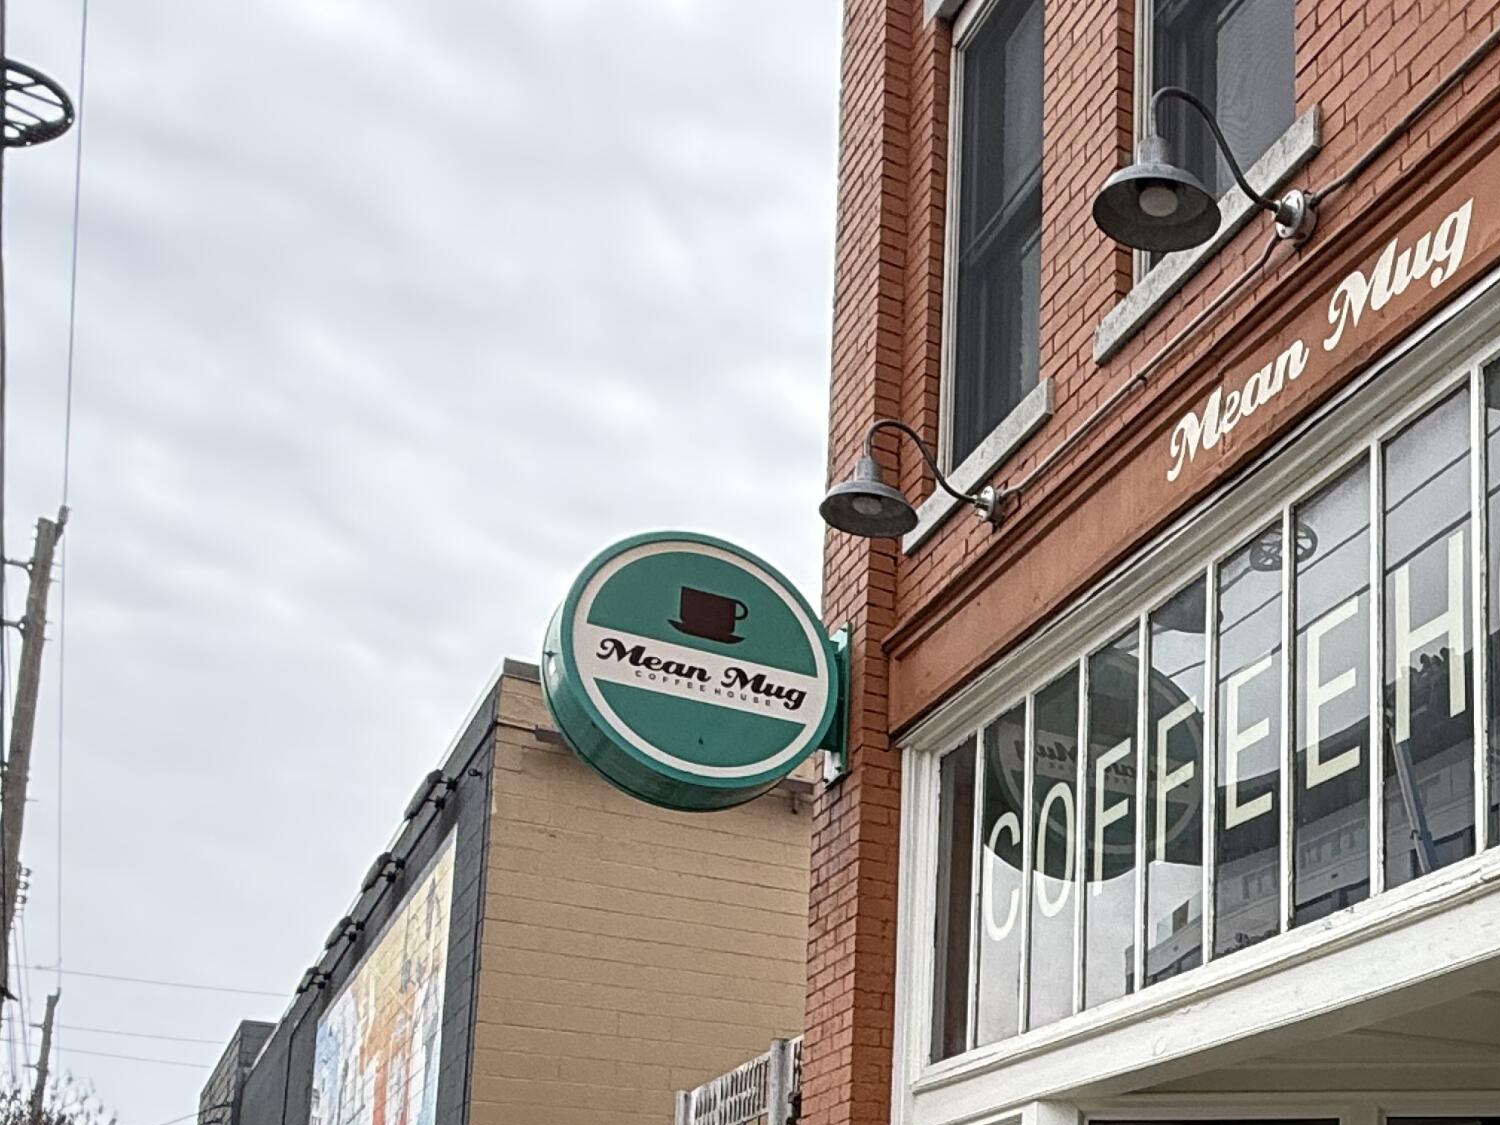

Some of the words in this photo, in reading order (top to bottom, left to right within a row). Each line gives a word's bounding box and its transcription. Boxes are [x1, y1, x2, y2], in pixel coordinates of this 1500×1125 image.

[1167, 340, 1309, 482] Mean
[1323, 197, 1474, 351] Mug
[596, 638, 711, 683] Mean
[721, 666, 807, 710] Mug
